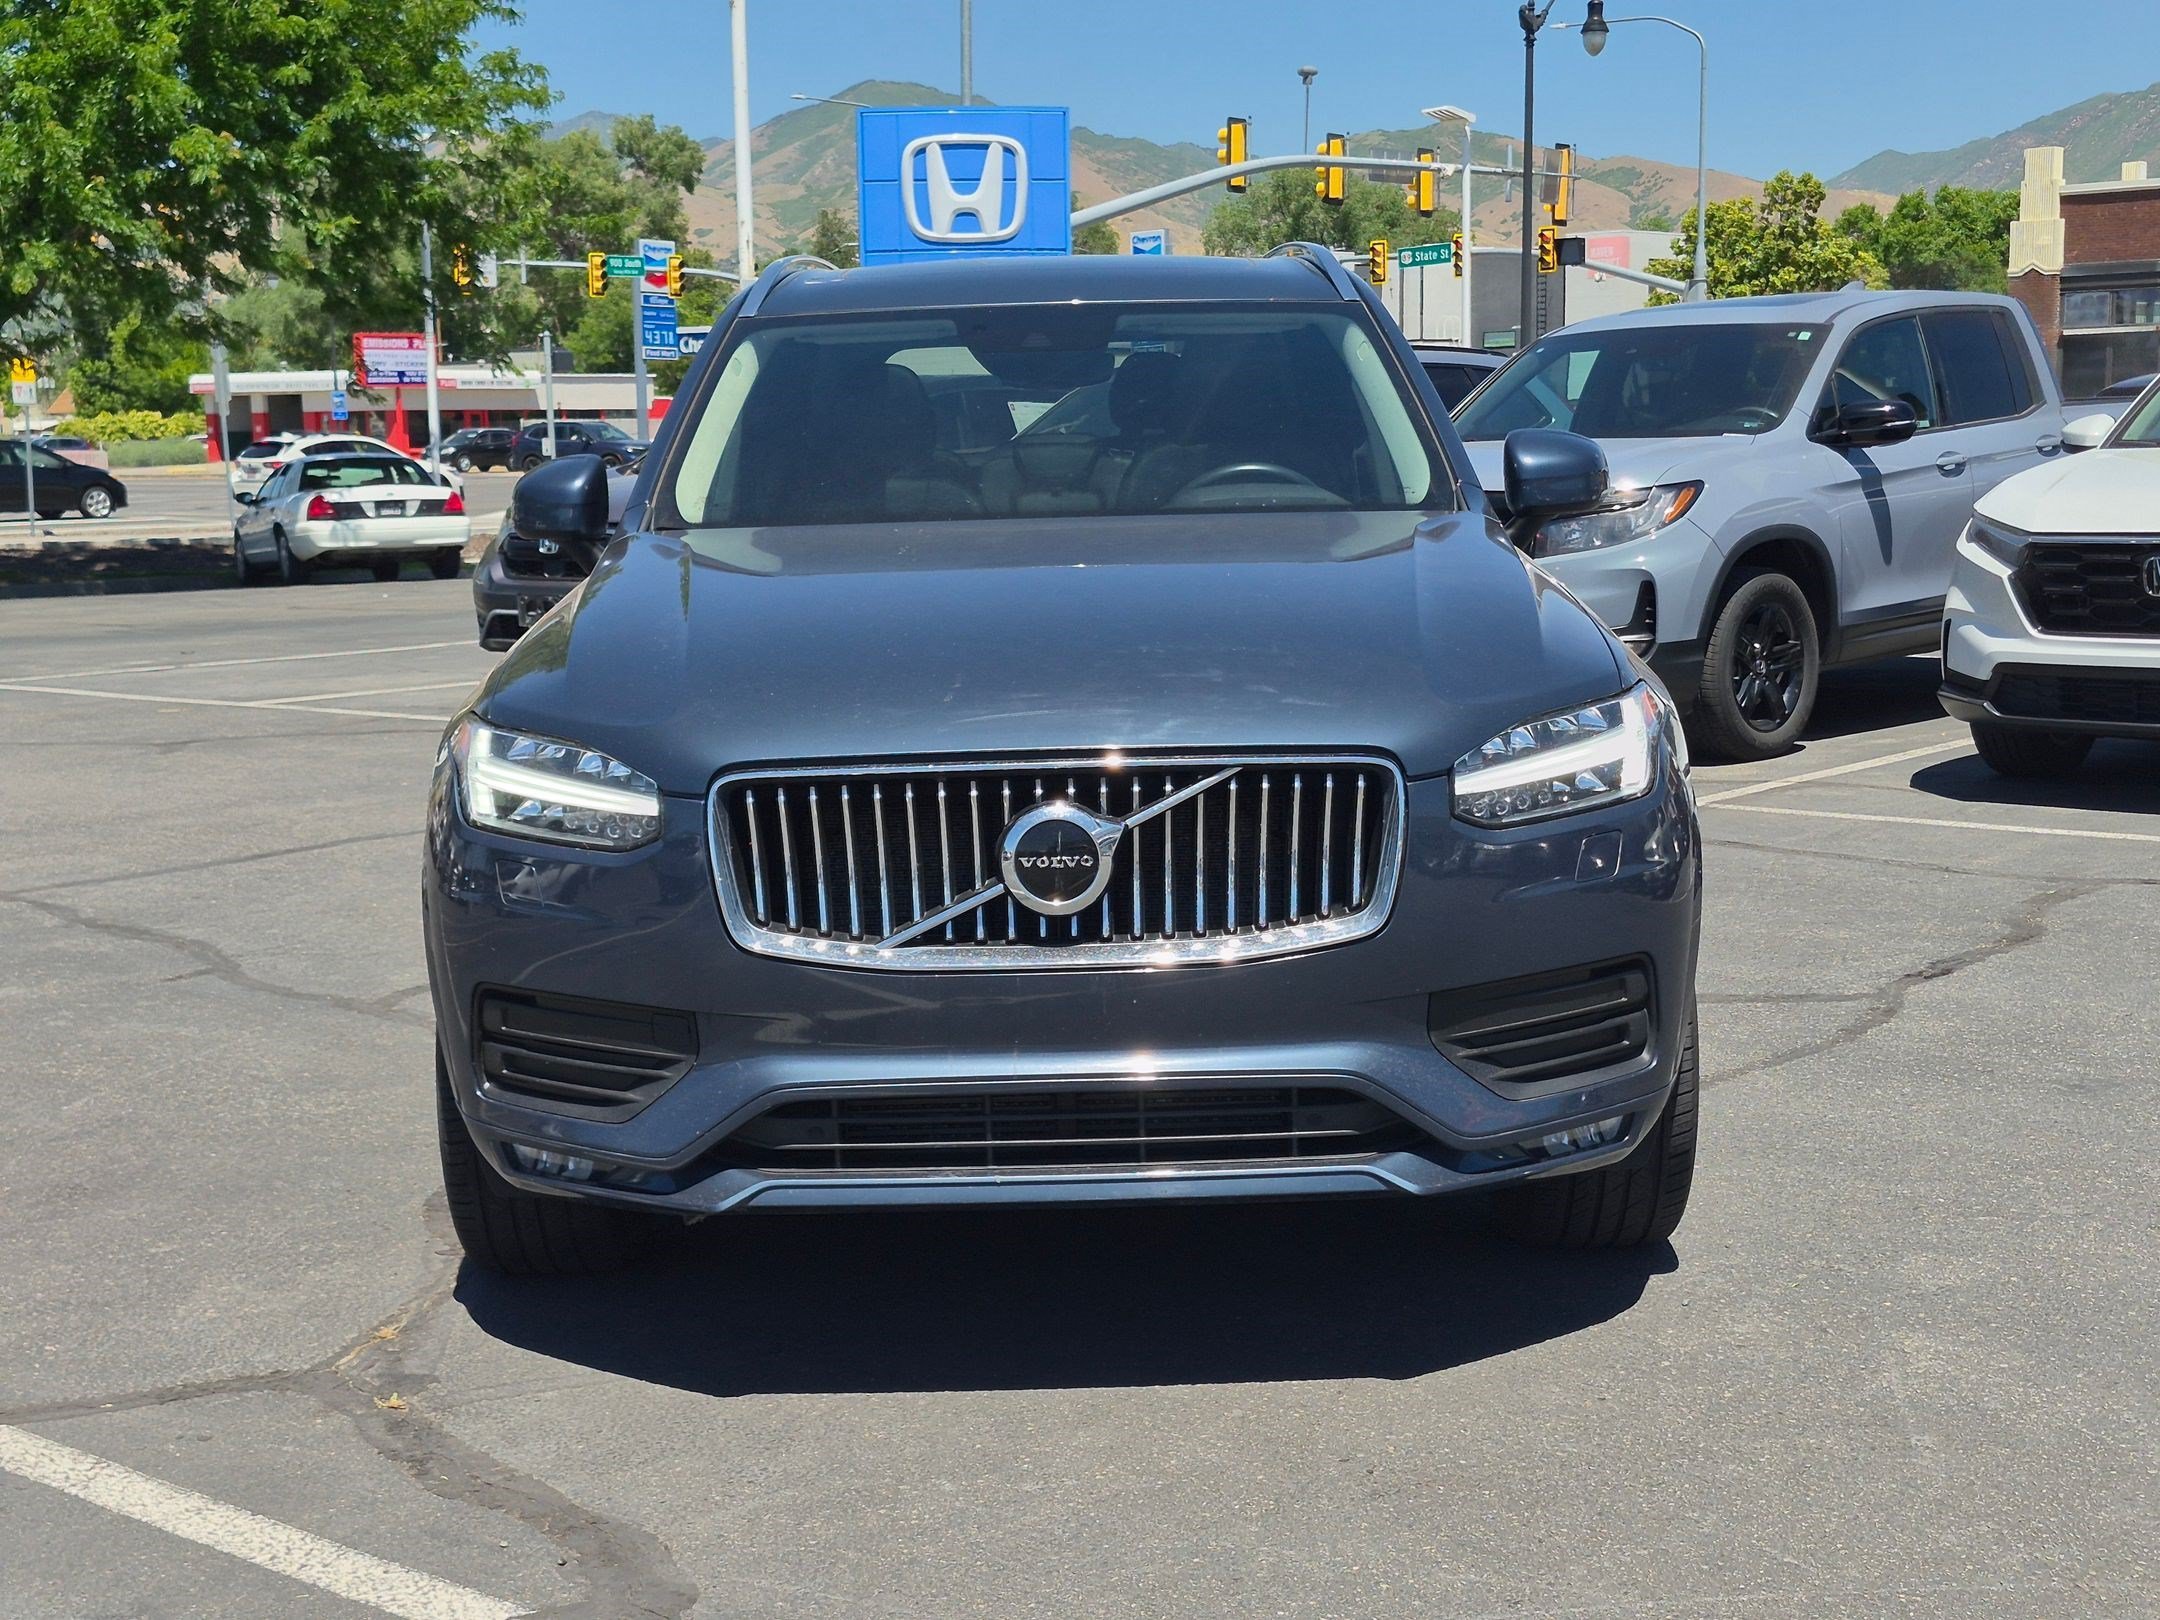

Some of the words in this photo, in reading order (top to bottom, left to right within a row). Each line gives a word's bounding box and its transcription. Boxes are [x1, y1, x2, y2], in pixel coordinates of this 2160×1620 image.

[1415, 251, 1438, 262] State
[1440, 249, 1449, 259] St
[610, 258, 622, 268] 900
[624, 258, 641, 268] South
[1018, 855, 1094, 868] VOLVO
